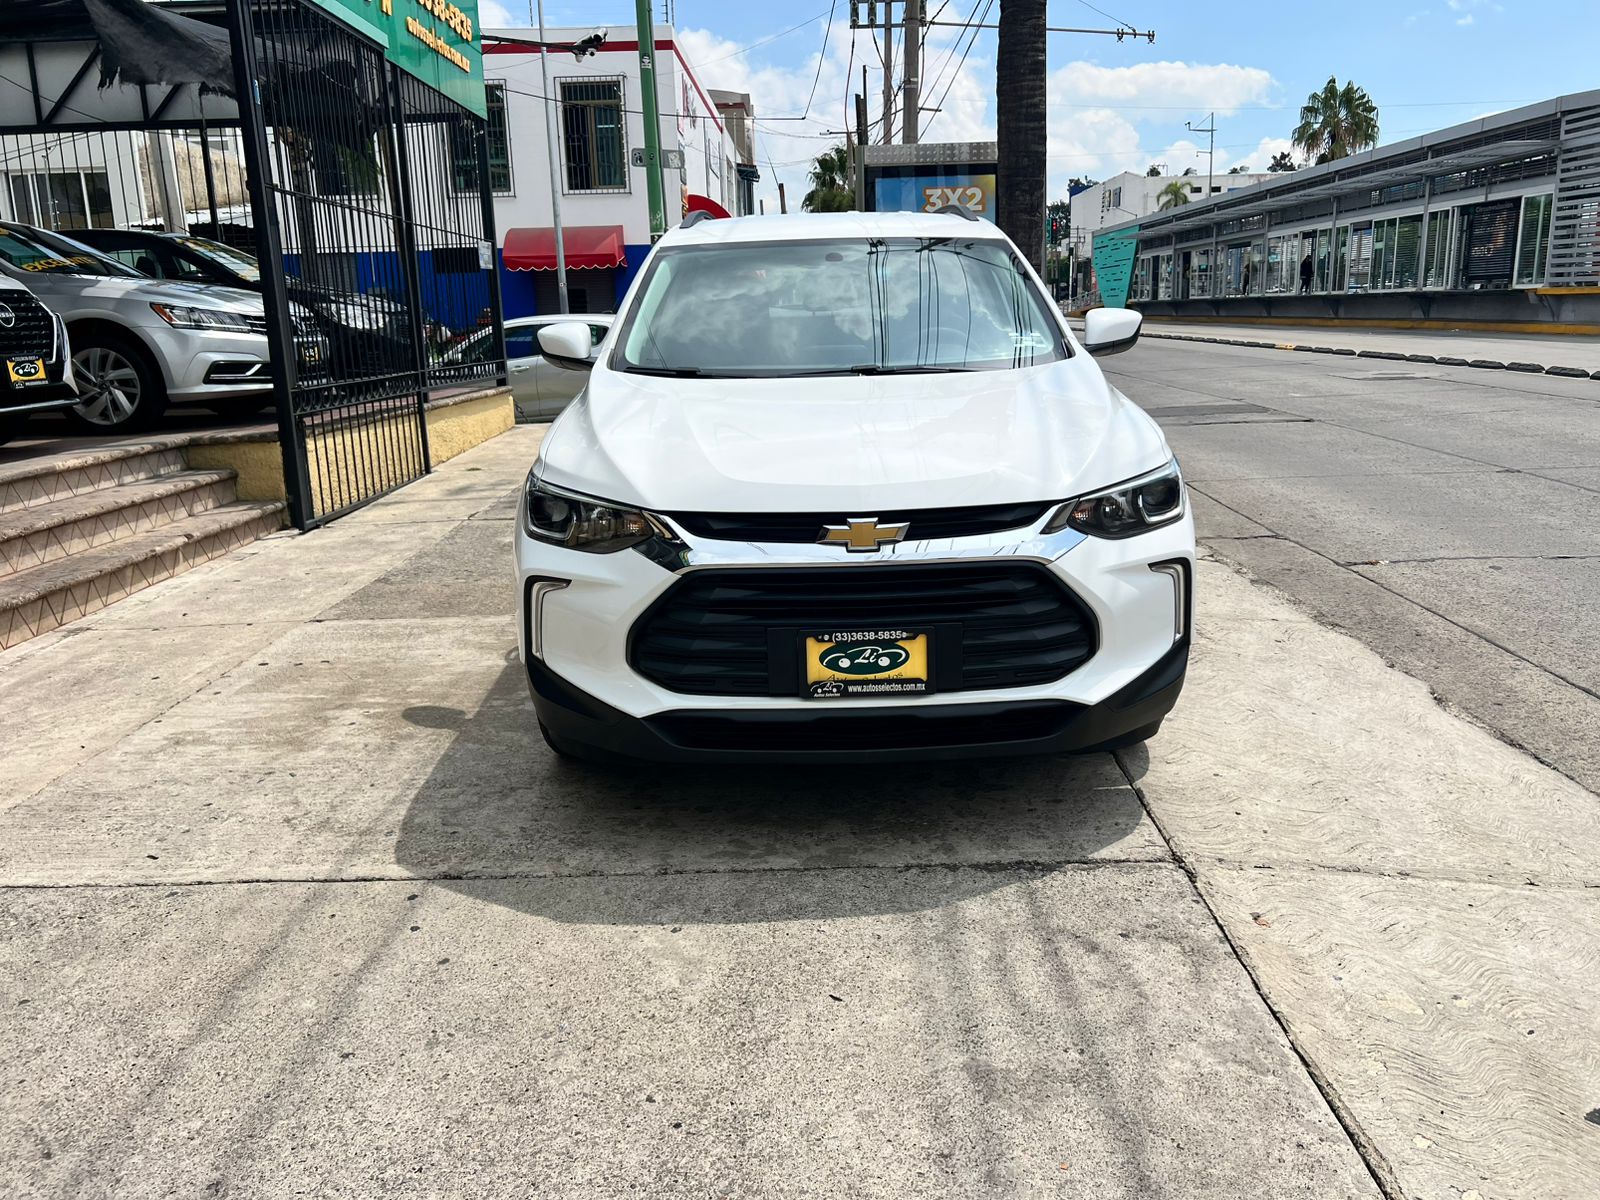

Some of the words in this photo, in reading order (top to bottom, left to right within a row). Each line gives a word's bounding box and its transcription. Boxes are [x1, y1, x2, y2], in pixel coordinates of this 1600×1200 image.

[924, 186, 983, 213] 3X2
[832, 631, 902, 642] (33)3638-5835
[854, 648, 877, 664] Li
[847, 682, 926, 693] www.autosselectos.com.mx
